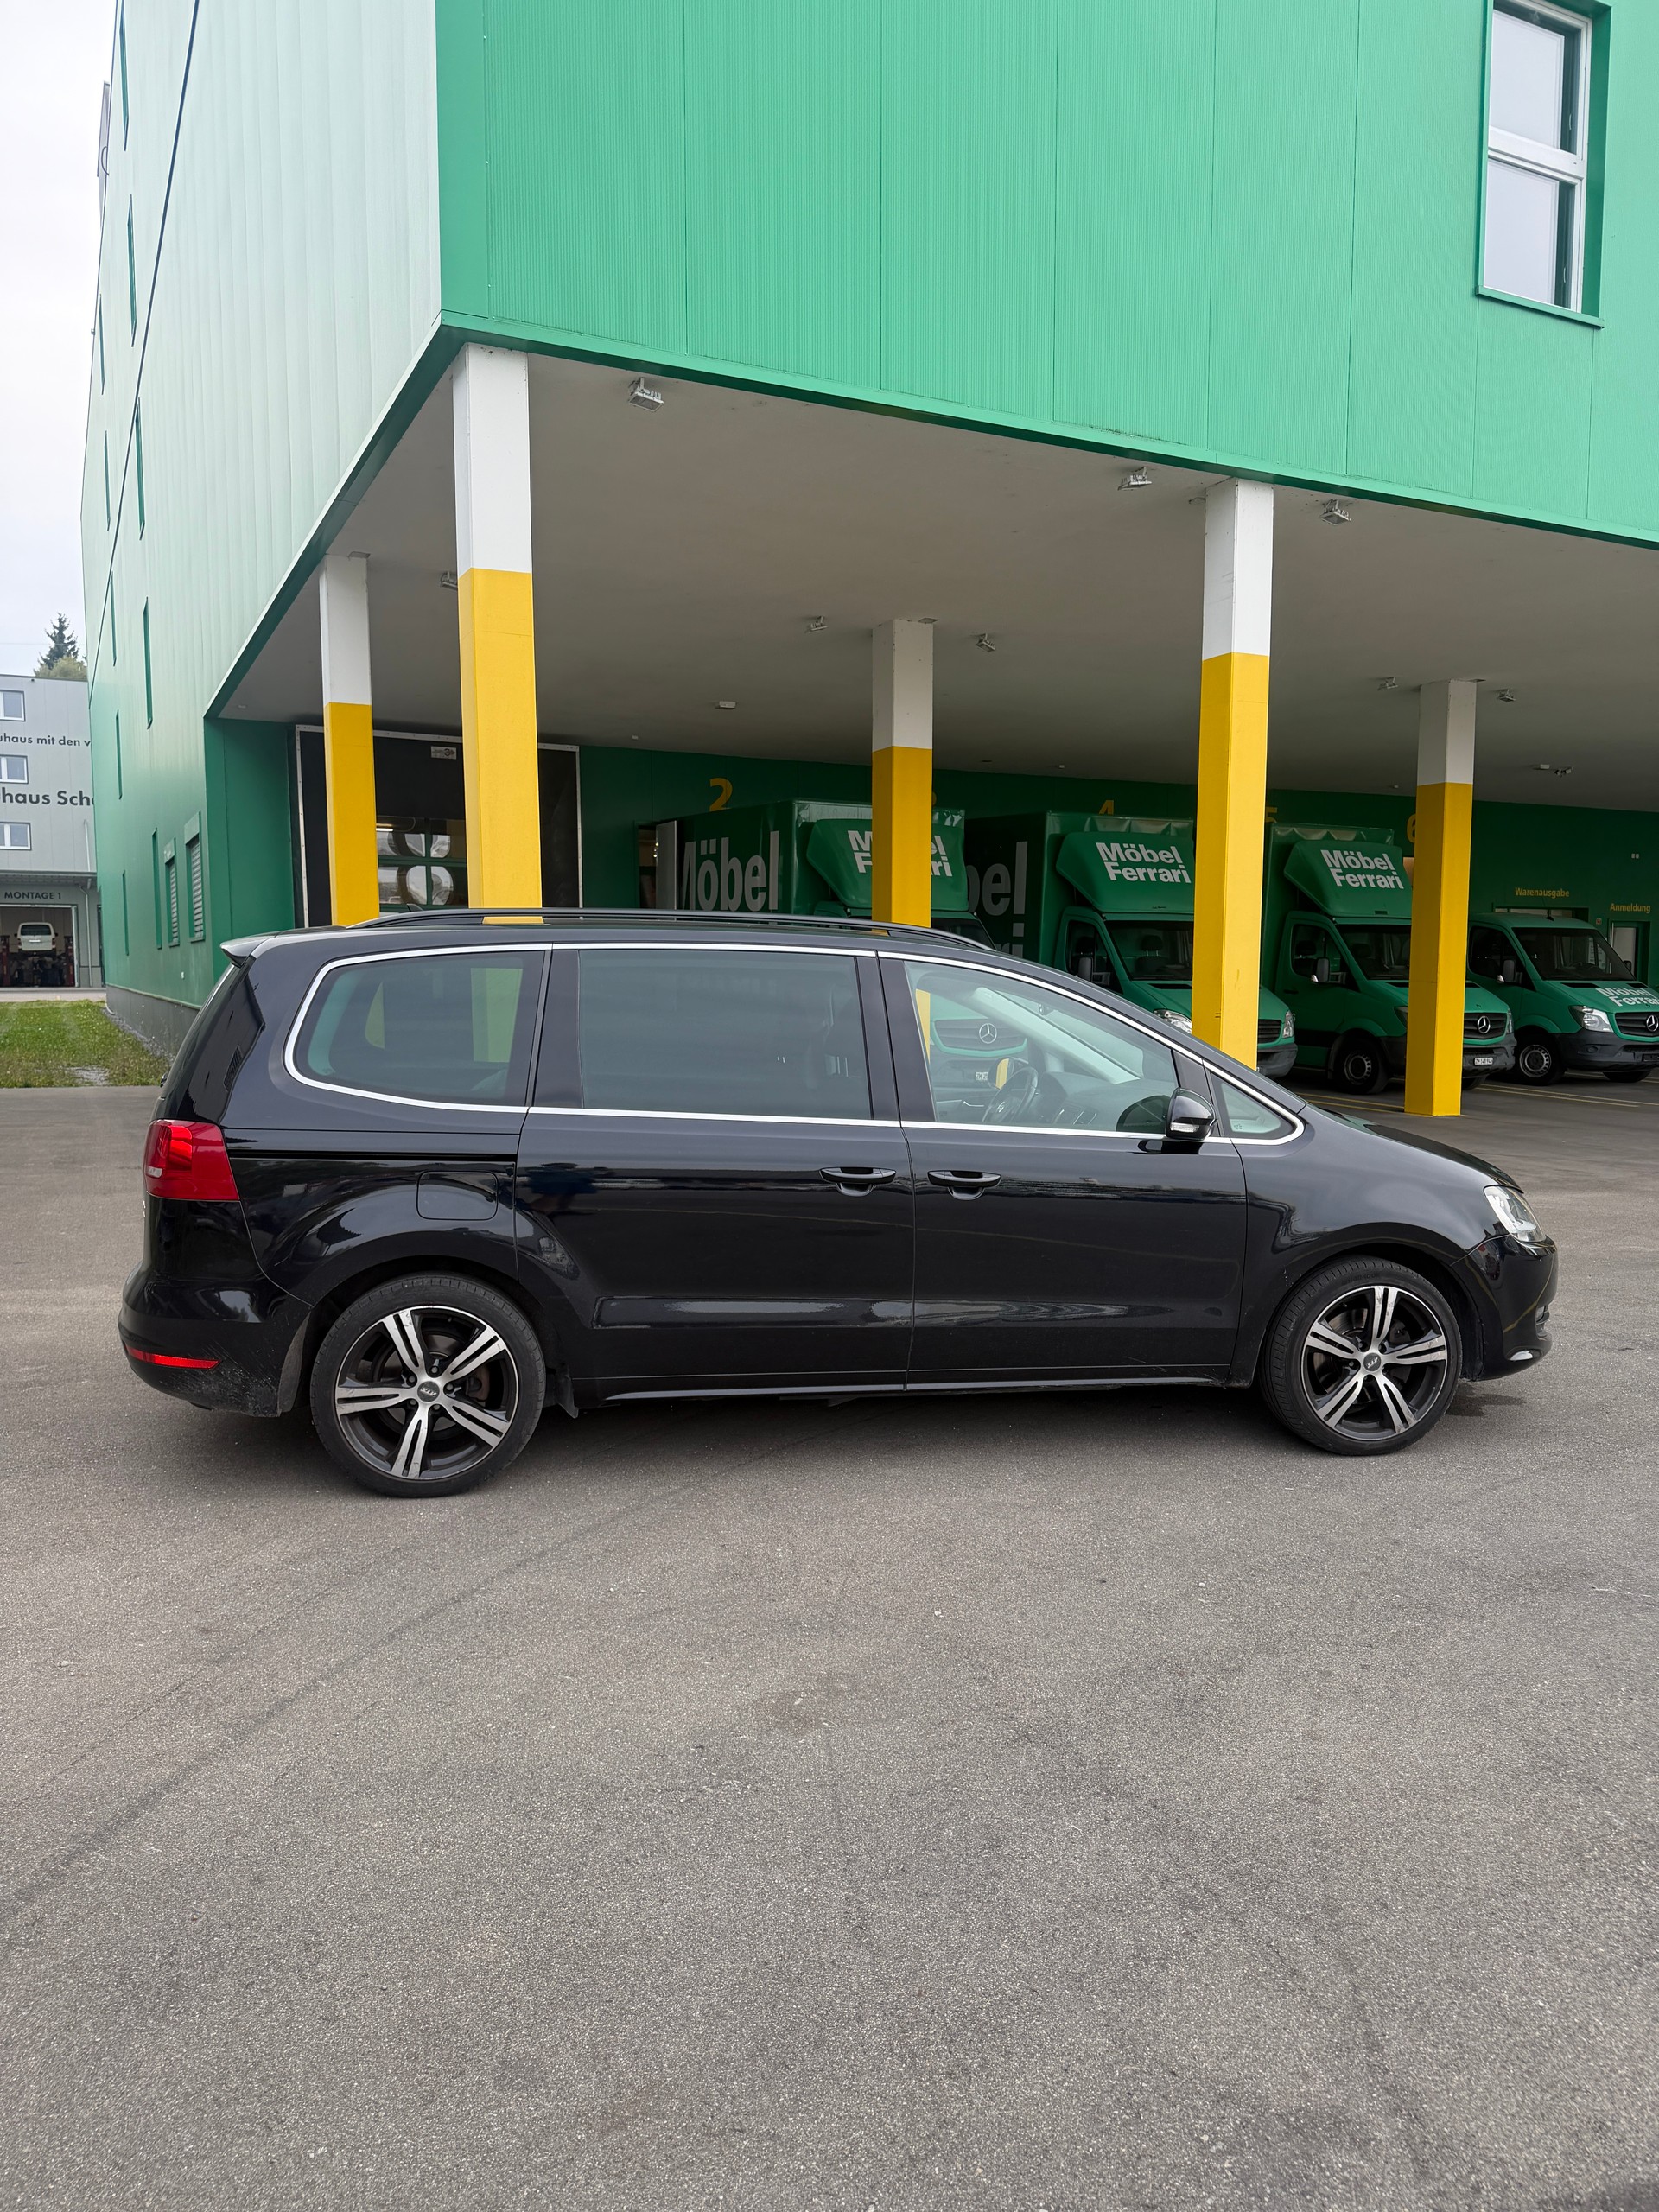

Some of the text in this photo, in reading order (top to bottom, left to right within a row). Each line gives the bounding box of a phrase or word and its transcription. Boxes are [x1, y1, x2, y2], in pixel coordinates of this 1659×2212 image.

[36, 735, 54, 745] mit
[58, 736, 80, 747] den
[0, 786, 95, 806] haus Sch
[709, 778, 733, 811] 2
[1096, 842, 1183, 864] Möbel
[1320, 849, 1395, 871] Möbel
[1103, 861, 1192, 883] Ferrari
[1330, 868, 1404, 889] Ferrari
[4, 891, 54, 899] MONTAGE
[1515, 887, 1570, 899] Warenausgabe
[1610, 903, 1651, 914] Anmeldung
[1595, 987, 1658, 999] Möbel
